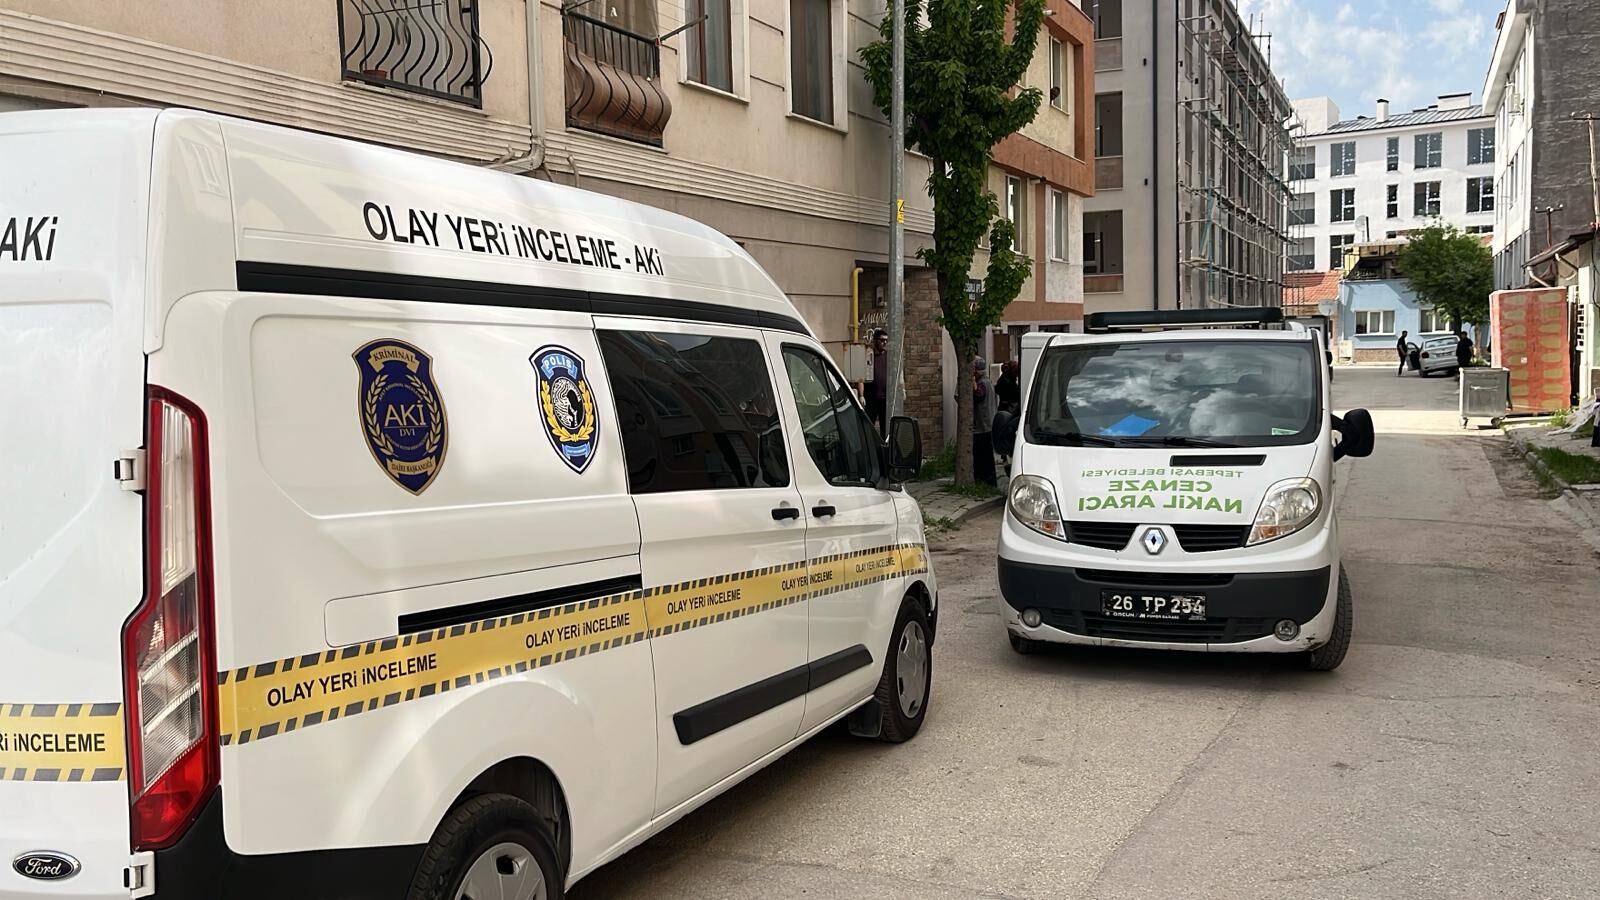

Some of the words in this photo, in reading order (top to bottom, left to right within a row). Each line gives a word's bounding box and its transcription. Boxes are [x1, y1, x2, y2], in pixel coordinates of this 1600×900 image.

[363, 201, 440, 247] OLAY
[373, 349, 416, 363] KRİMİNAL
[544, 355, 572, 369] POLİS
[384, 400, 426, 426] AKİ
[399, 428, 416, 437] DVI
[782, 578, 797, 591] OLAY
[667, 601, 689, 615] OLAY
[1112, 595, 1133, 610] 26
[1141, 596, 1166, 612] TP
[1170, 598, 1201, 614] 254
[526, 629, 555, 649] OLAY
[267, 679, 315, 707] OLAY
[24, 857, 62, 875] Ford
